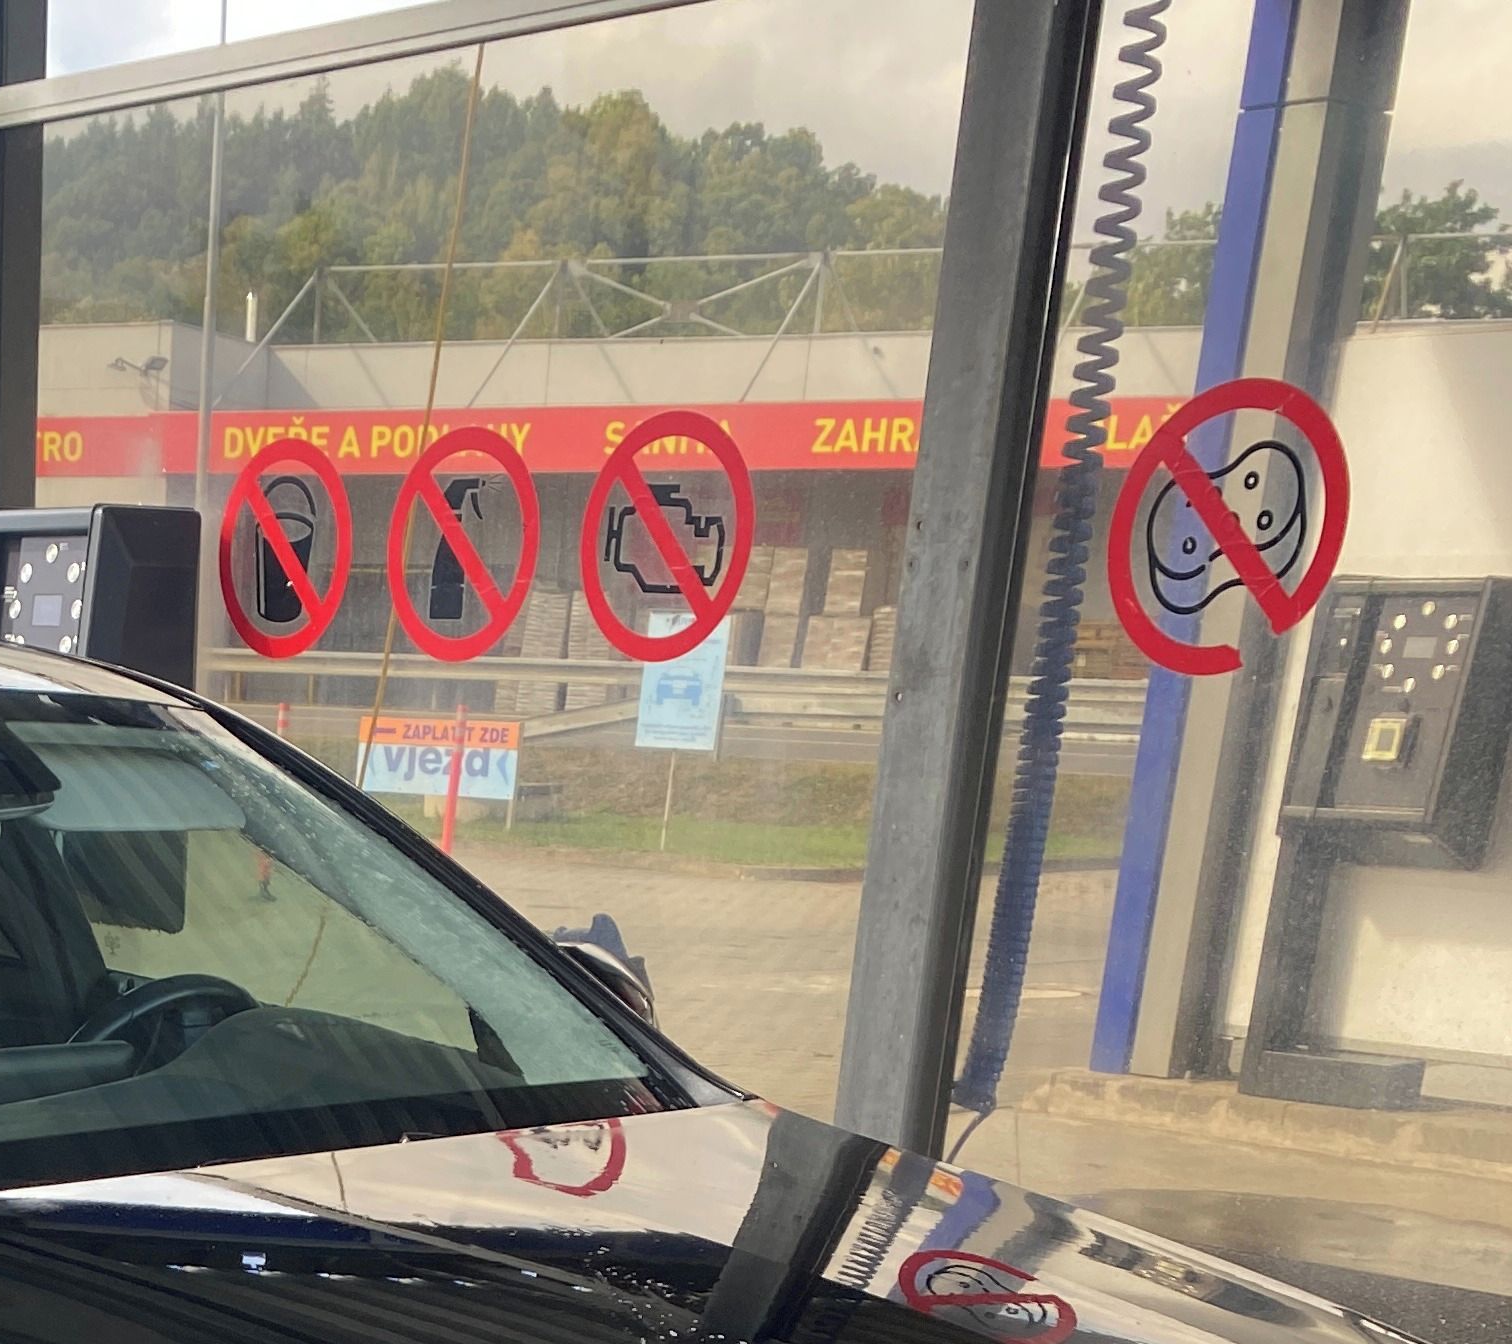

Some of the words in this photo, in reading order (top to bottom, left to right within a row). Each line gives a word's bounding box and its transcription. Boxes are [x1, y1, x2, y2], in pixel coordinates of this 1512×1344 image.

[37, 430, 84, 463] RO
[338, 425, 362, 458] A
[811, 417, 920, 453] ZAHR
[402, 724, 475, 742] ZAPLATT
[479, 727, 510, 744] ZDE
